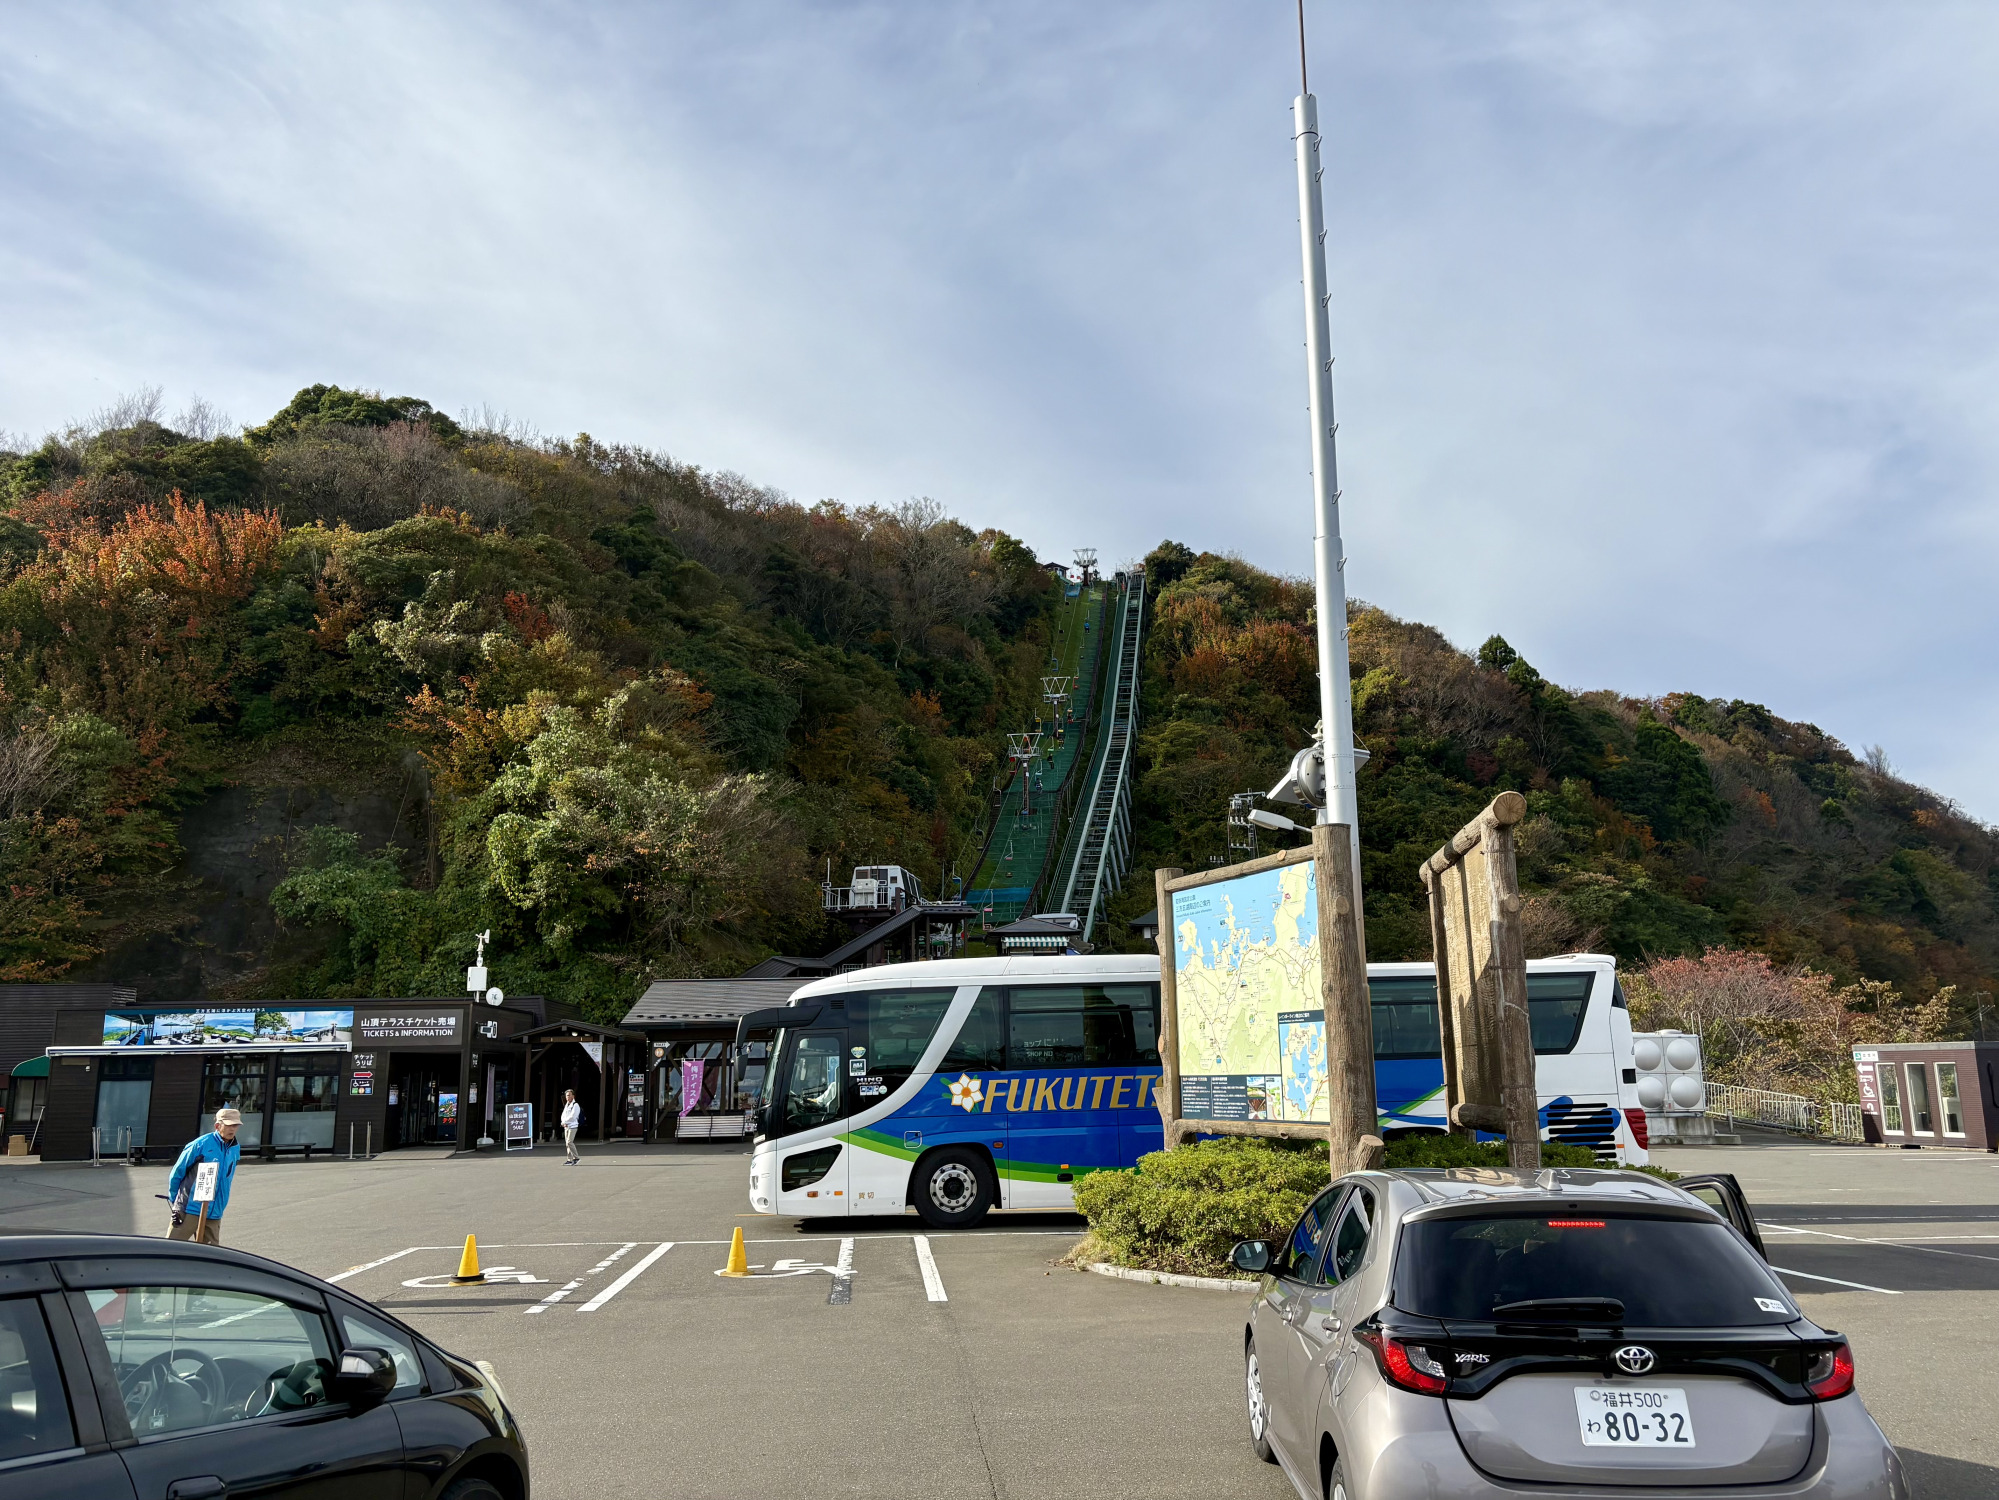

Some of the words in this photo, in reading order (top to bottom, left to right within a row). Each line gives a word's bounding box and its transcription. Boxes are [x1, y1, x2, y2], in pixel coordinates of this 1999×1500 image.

[361, 1017, 456, 1027] 山頂テラスチケット売場
[1454, 1353, 1490, 1364] YARIS
[1586, 1418, 1601, 1434] わ
[1604, 1411, 1689, 1443] 80-32
